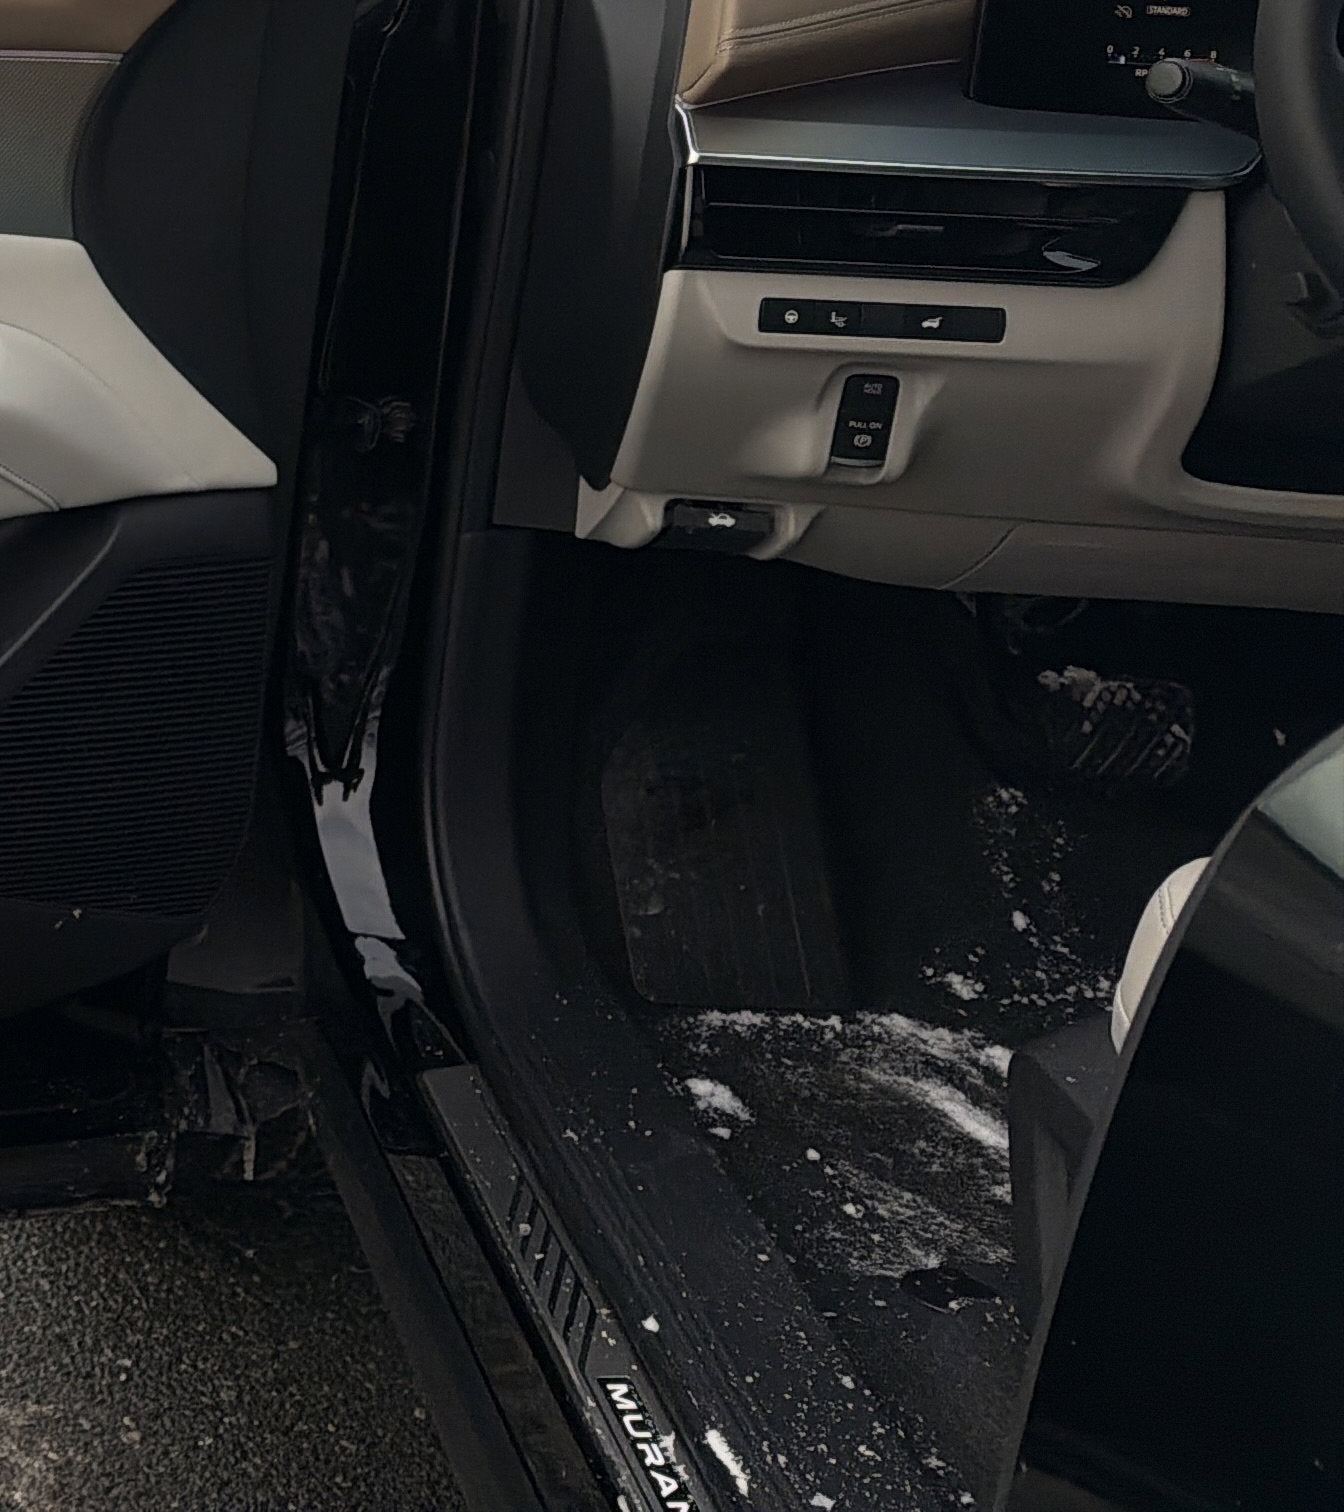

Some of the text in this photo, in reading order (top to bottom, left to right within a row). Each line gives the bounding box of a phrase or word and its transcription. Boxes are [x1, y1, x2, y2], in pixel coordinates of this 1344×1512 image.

[1148, 6, 1189, 17] STANDARD
[1107, 45, 1114, 54] 0
[1131, 46, 1140, 55] 2
[1184, 49, 1191, 57] 6
[1135, 68, 1149, 77] RP
[848, 420, 883, 430] PULL ON
